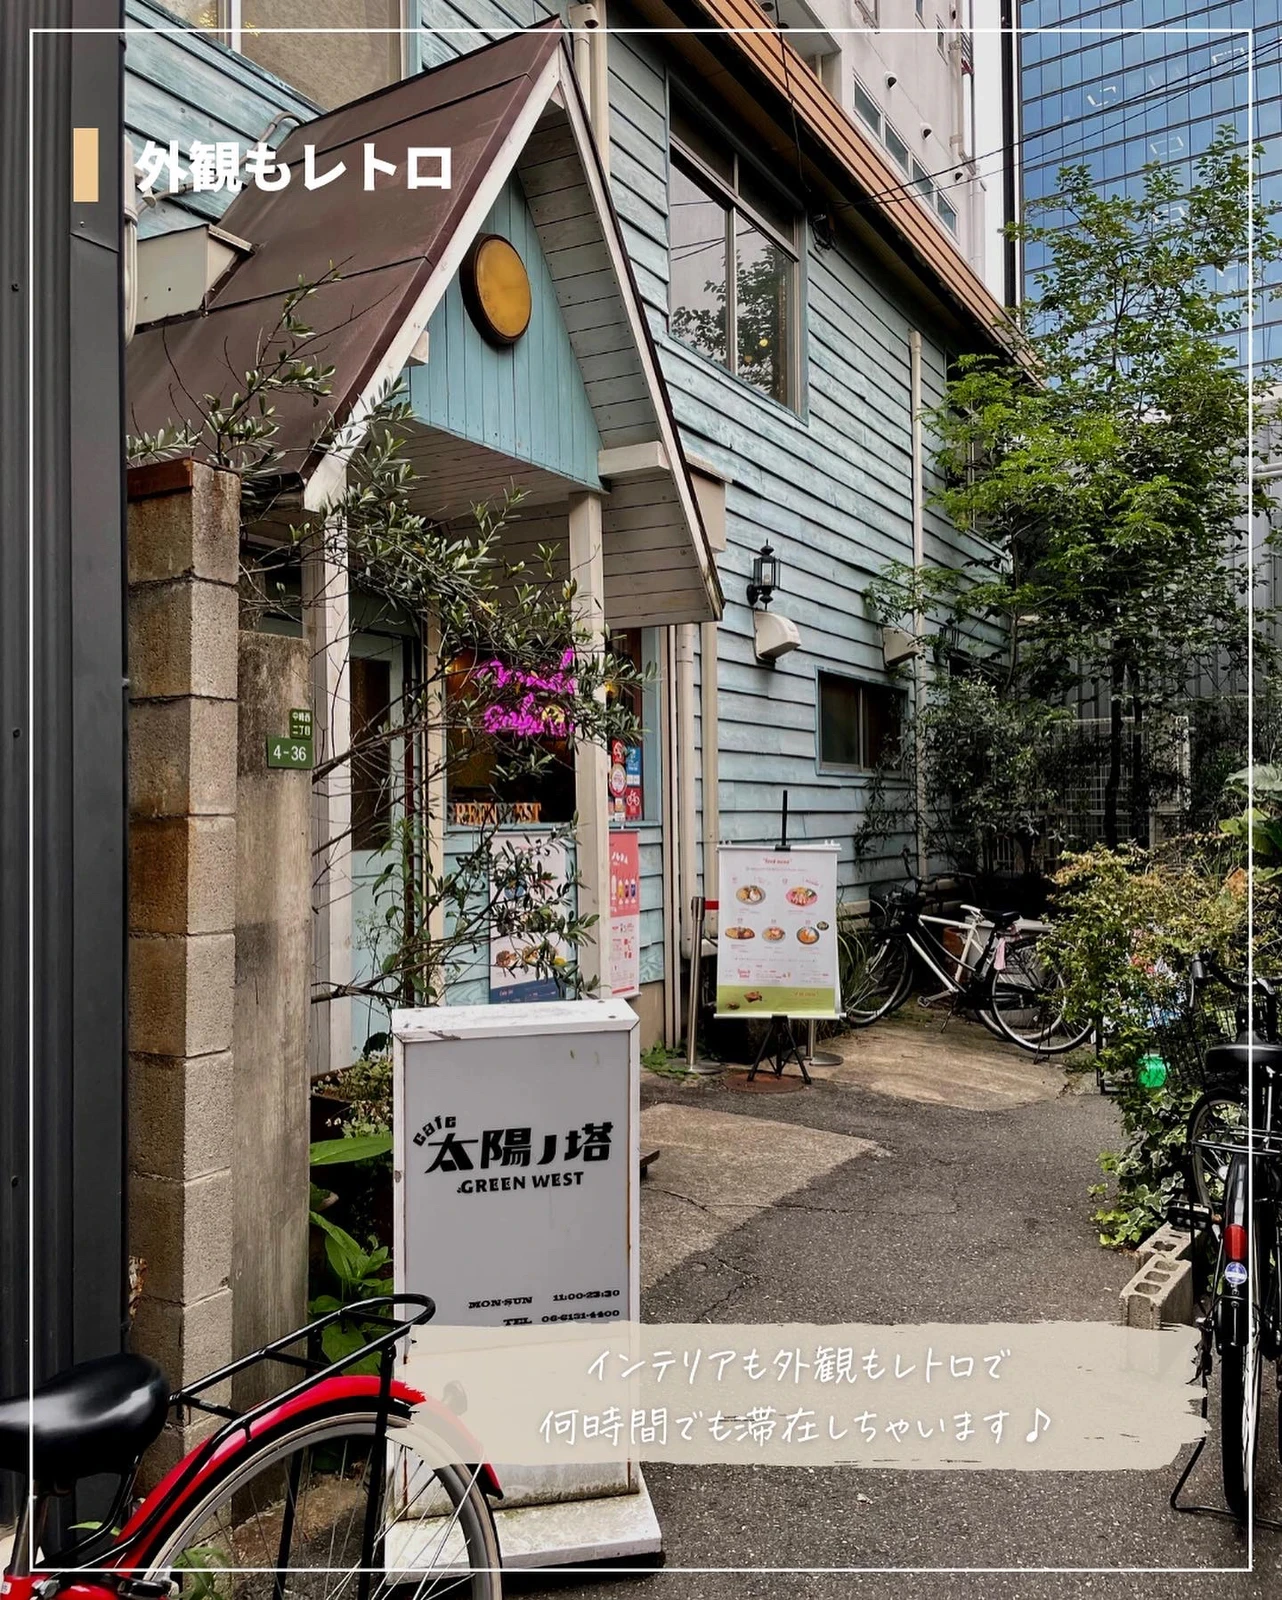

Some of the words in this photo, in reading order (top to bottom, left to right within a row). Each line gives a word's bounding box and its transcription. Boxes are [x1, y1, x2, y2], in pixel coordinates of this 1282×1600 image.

[273, 744, 307, 762] 4-36
[412, 1115, 457, 1147] cafe
[424, 1121, 614, 1174] 太陽ノ塔
[459, 1175, 526, 1194] GREEN
[532, 1171, 584, 1188] WEST
[503, 1317, 533, 1326] TEL
